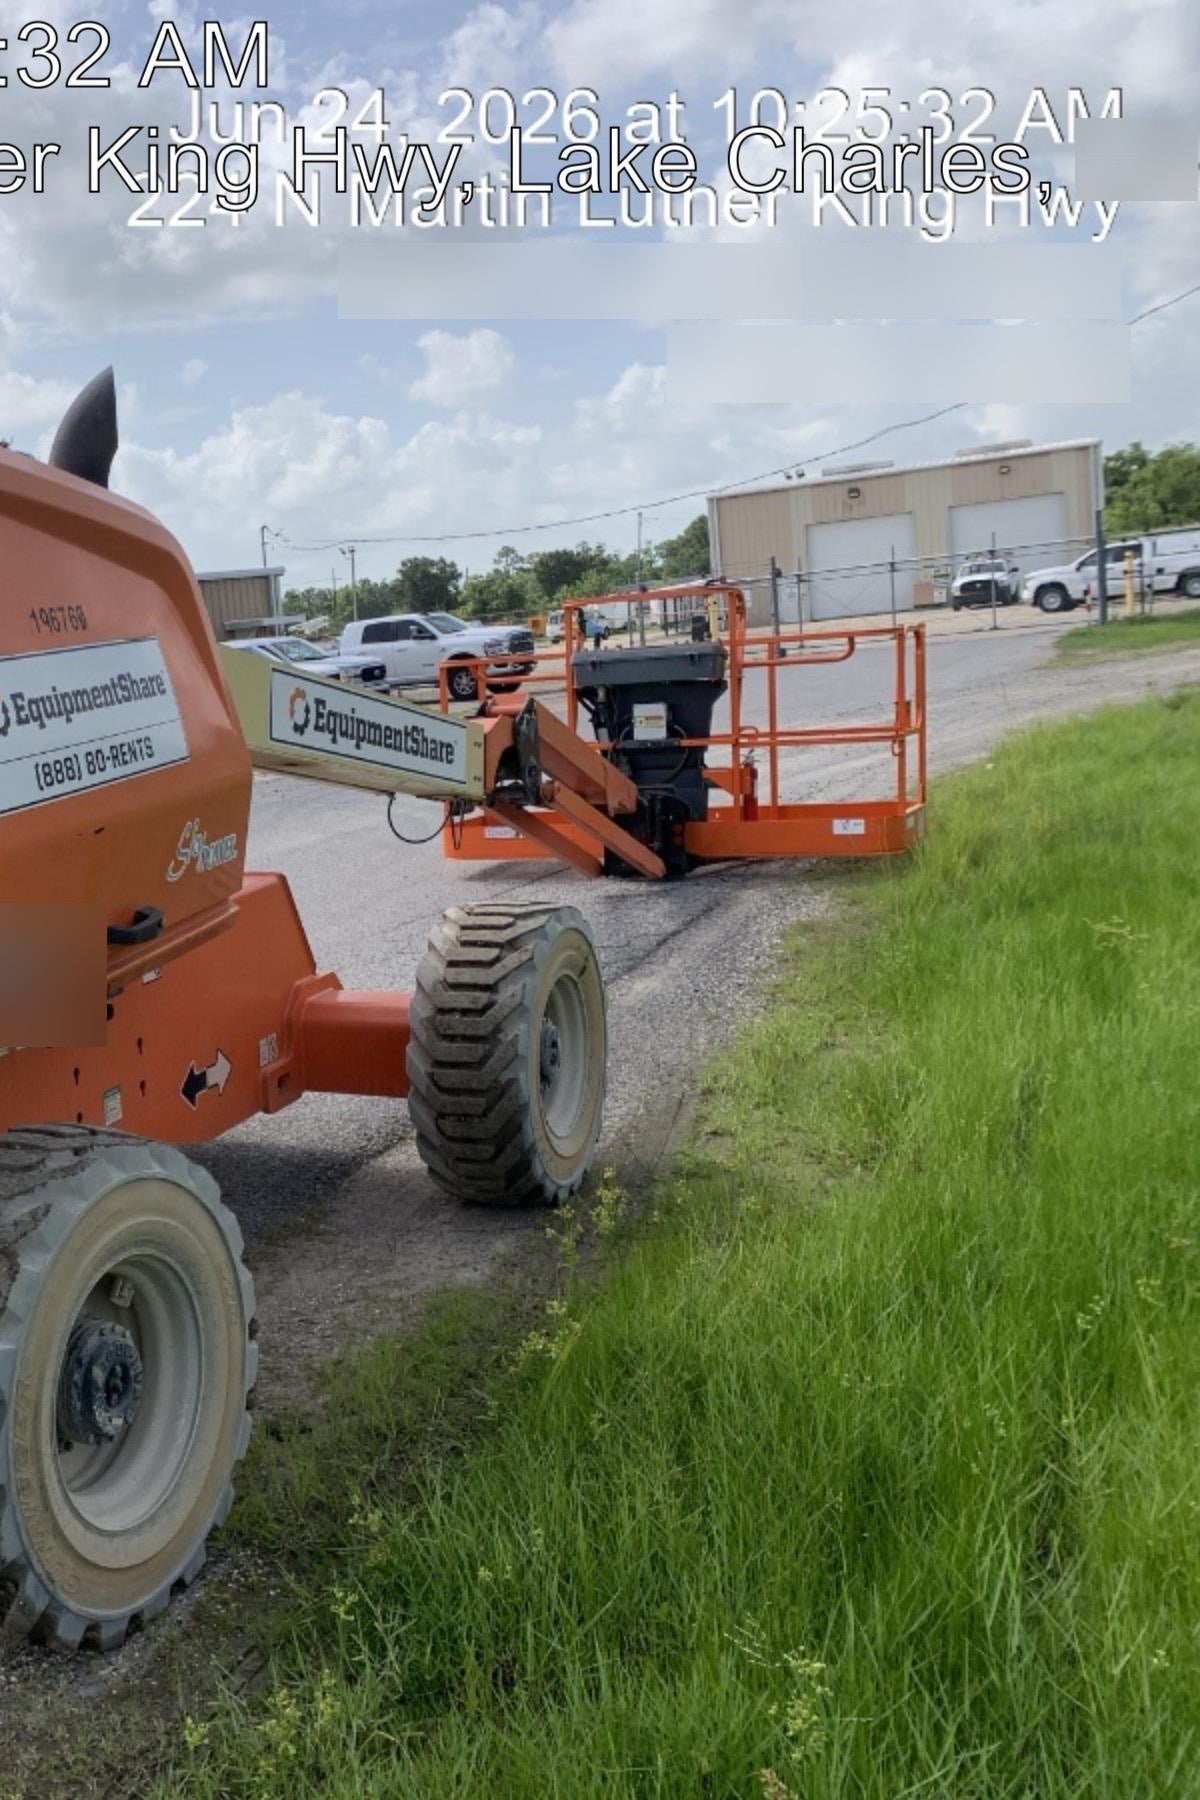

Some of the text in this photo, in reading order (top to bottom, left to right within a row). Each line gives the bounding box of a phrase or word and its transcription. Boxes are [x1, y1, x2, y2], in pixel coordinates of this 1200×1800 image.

[10, 672, 167, 730] EquipmentShare
[313, 697, 455, 765] EquipmentShare
[34, 736, 155, 791] (888) 80-RENTS
